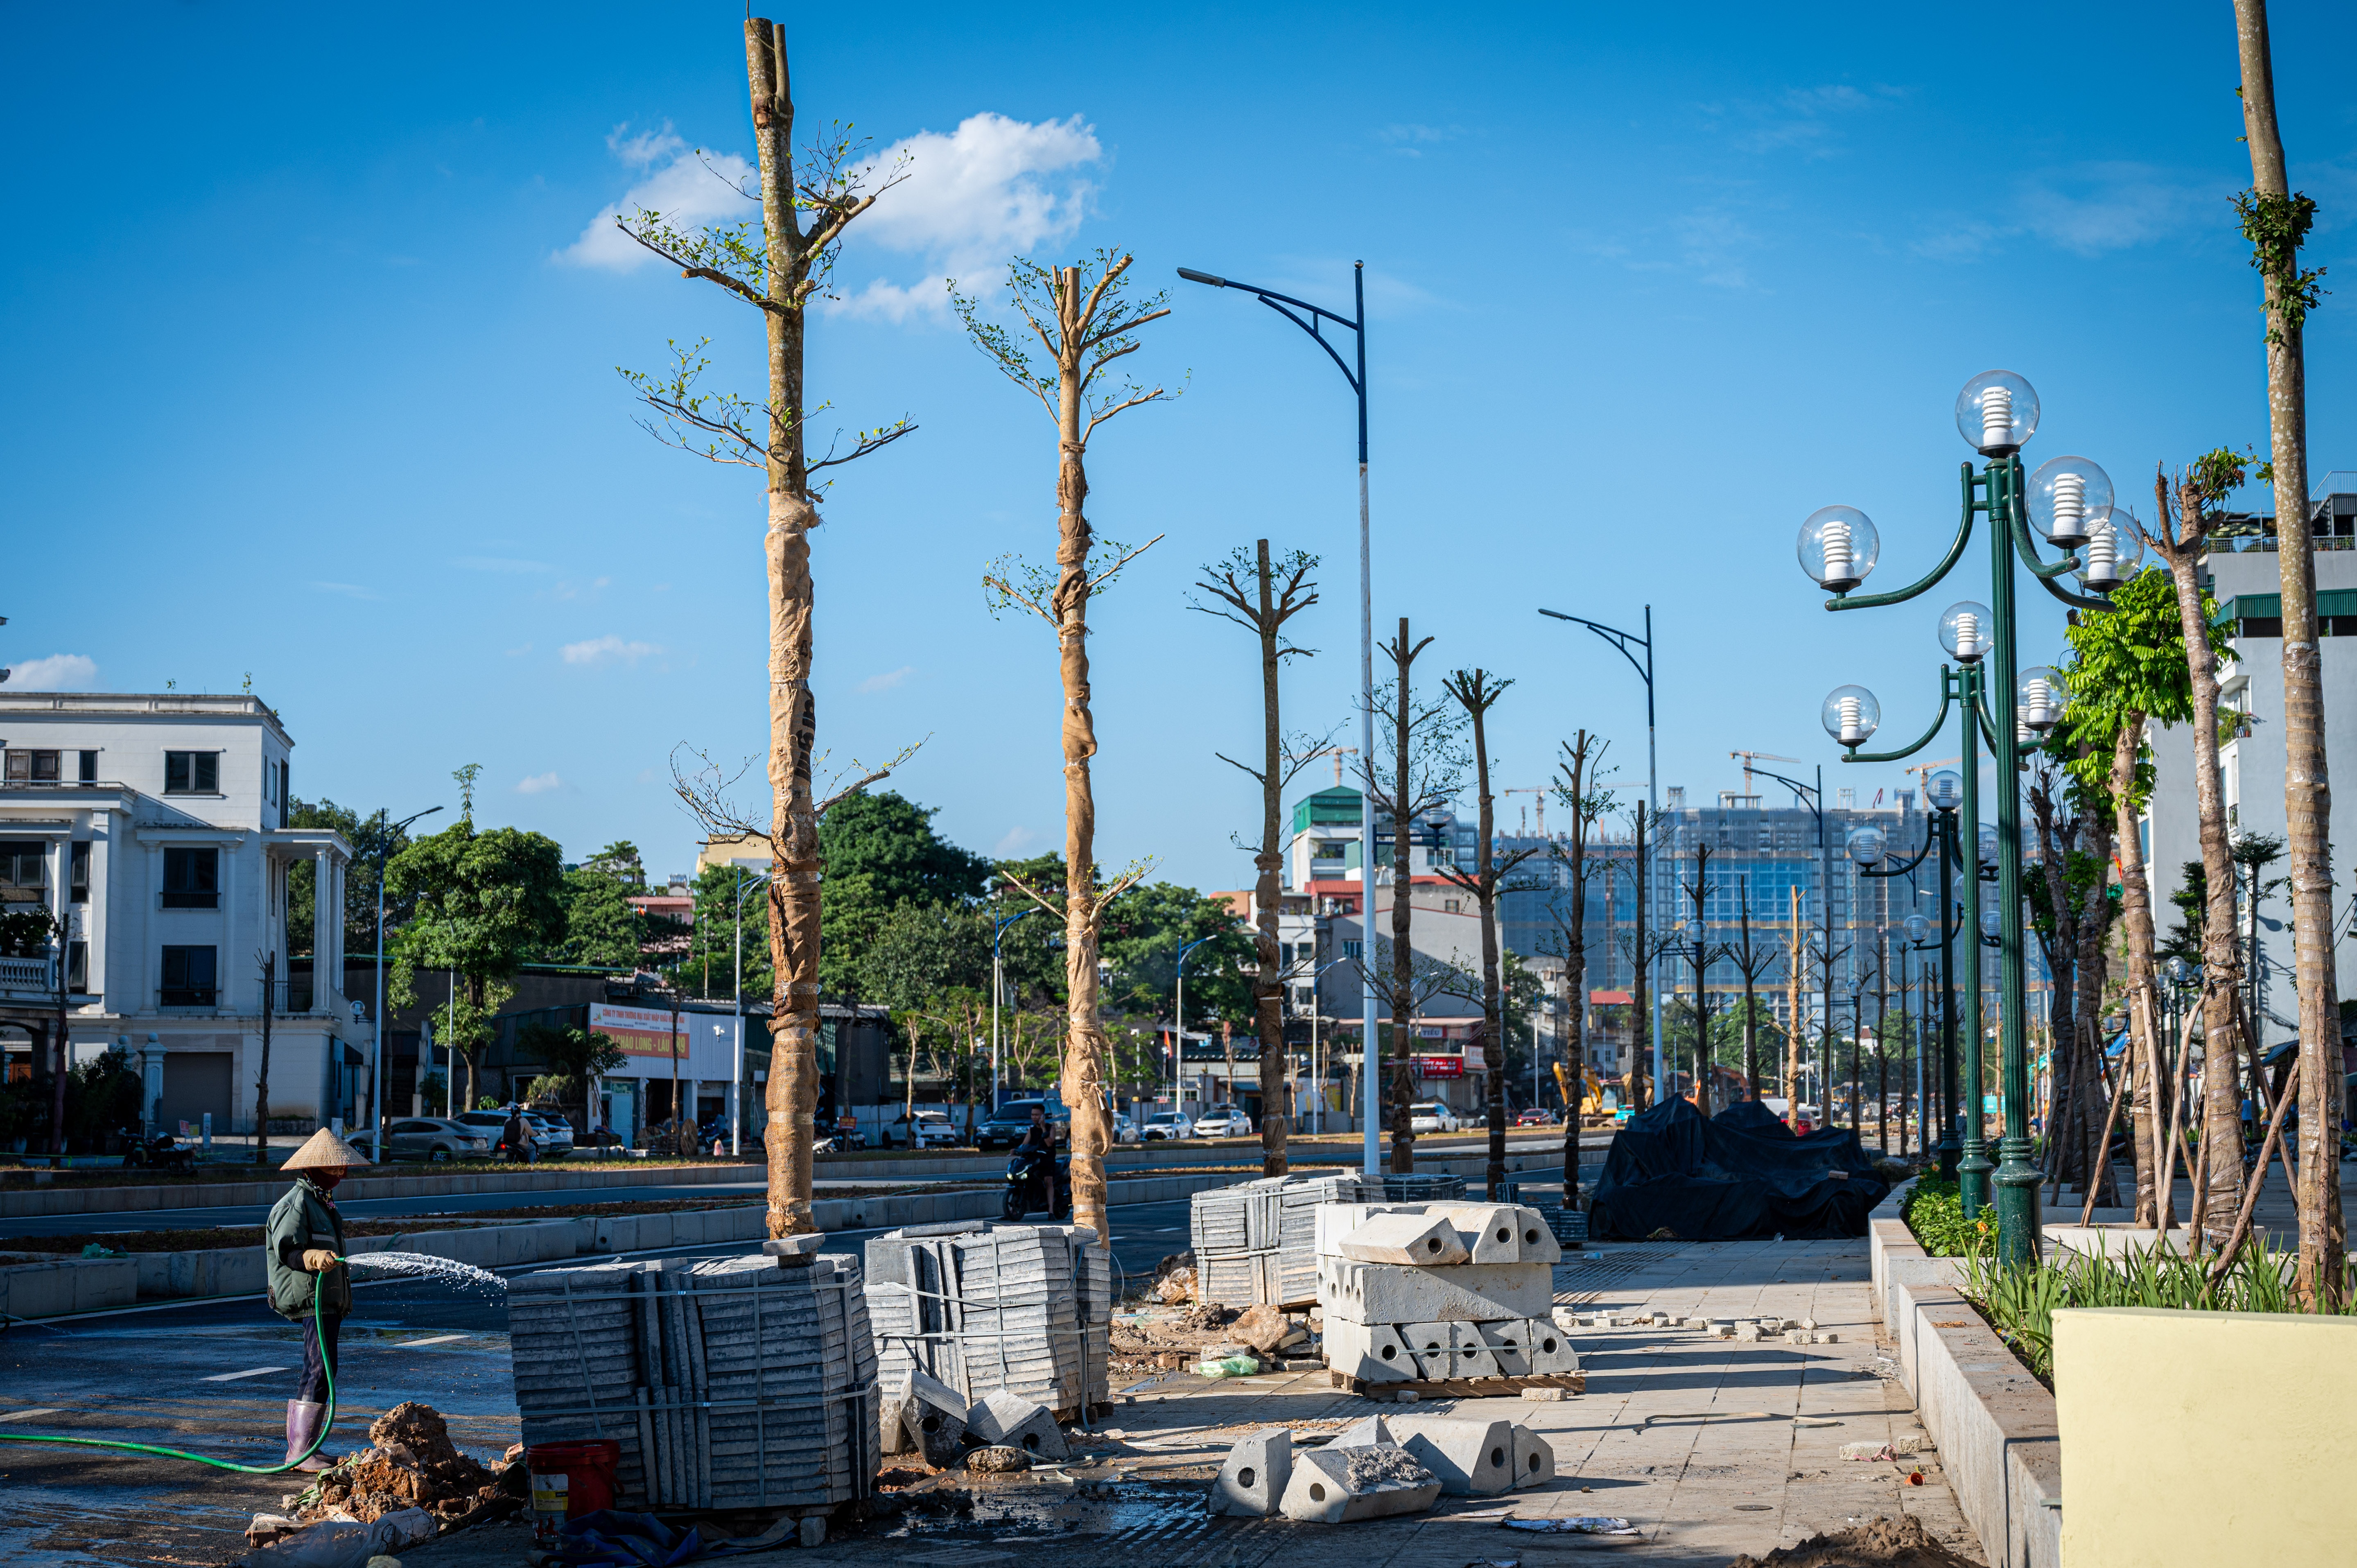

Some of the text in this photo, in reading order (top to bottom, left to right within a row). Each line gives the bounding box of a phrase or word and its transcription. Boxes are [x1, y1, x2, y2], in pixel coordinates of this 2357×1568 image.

[612, 1009, 615, 1017] TY
[616, 1033, 633, 1050] CHÁO
[635, 1033, 652, 1051] LÒNG
